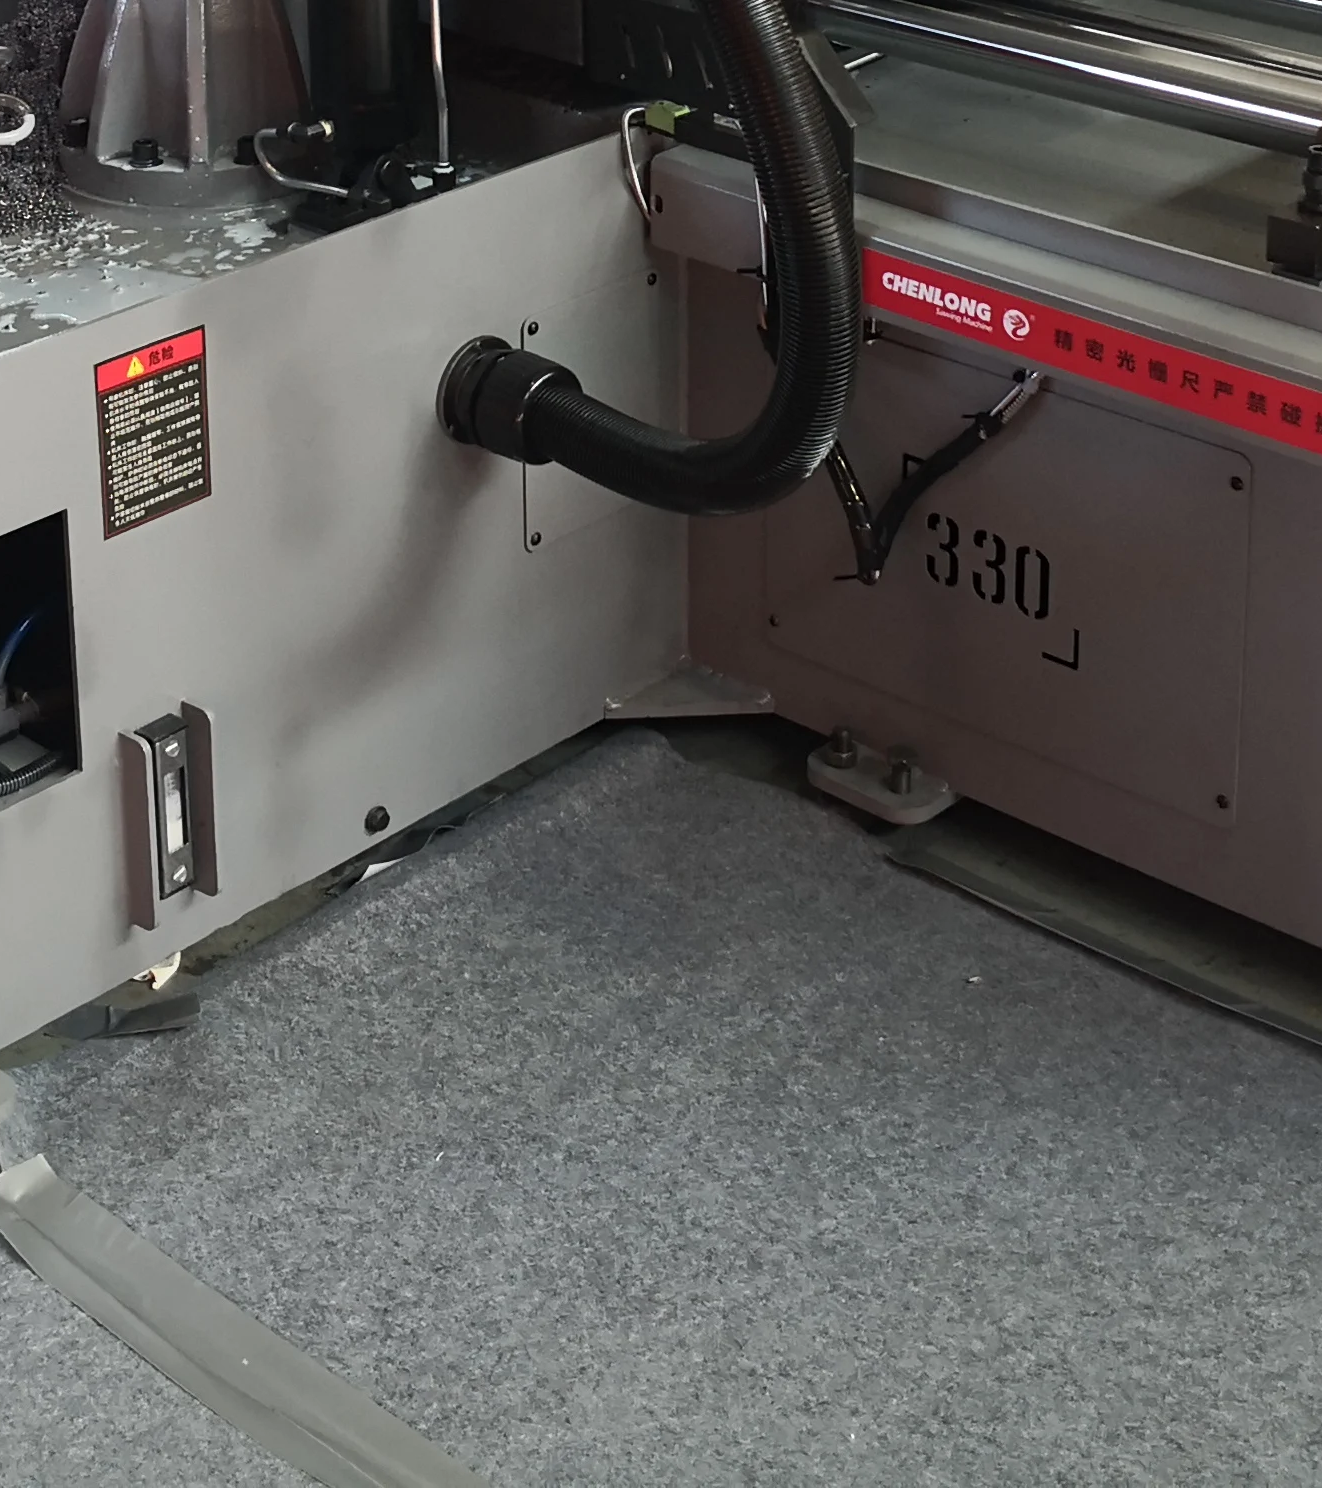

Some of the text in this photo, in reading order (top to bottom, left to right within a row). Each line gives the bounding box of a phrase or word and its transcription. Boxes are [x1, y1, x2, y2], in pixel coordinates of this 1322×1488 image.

[882, 271, 992, 322] CHENLONG
[963, 316, 994, 333] Machine
[149, 345, 174, 367] 危险
[926, 512, 1050, 620] 330
